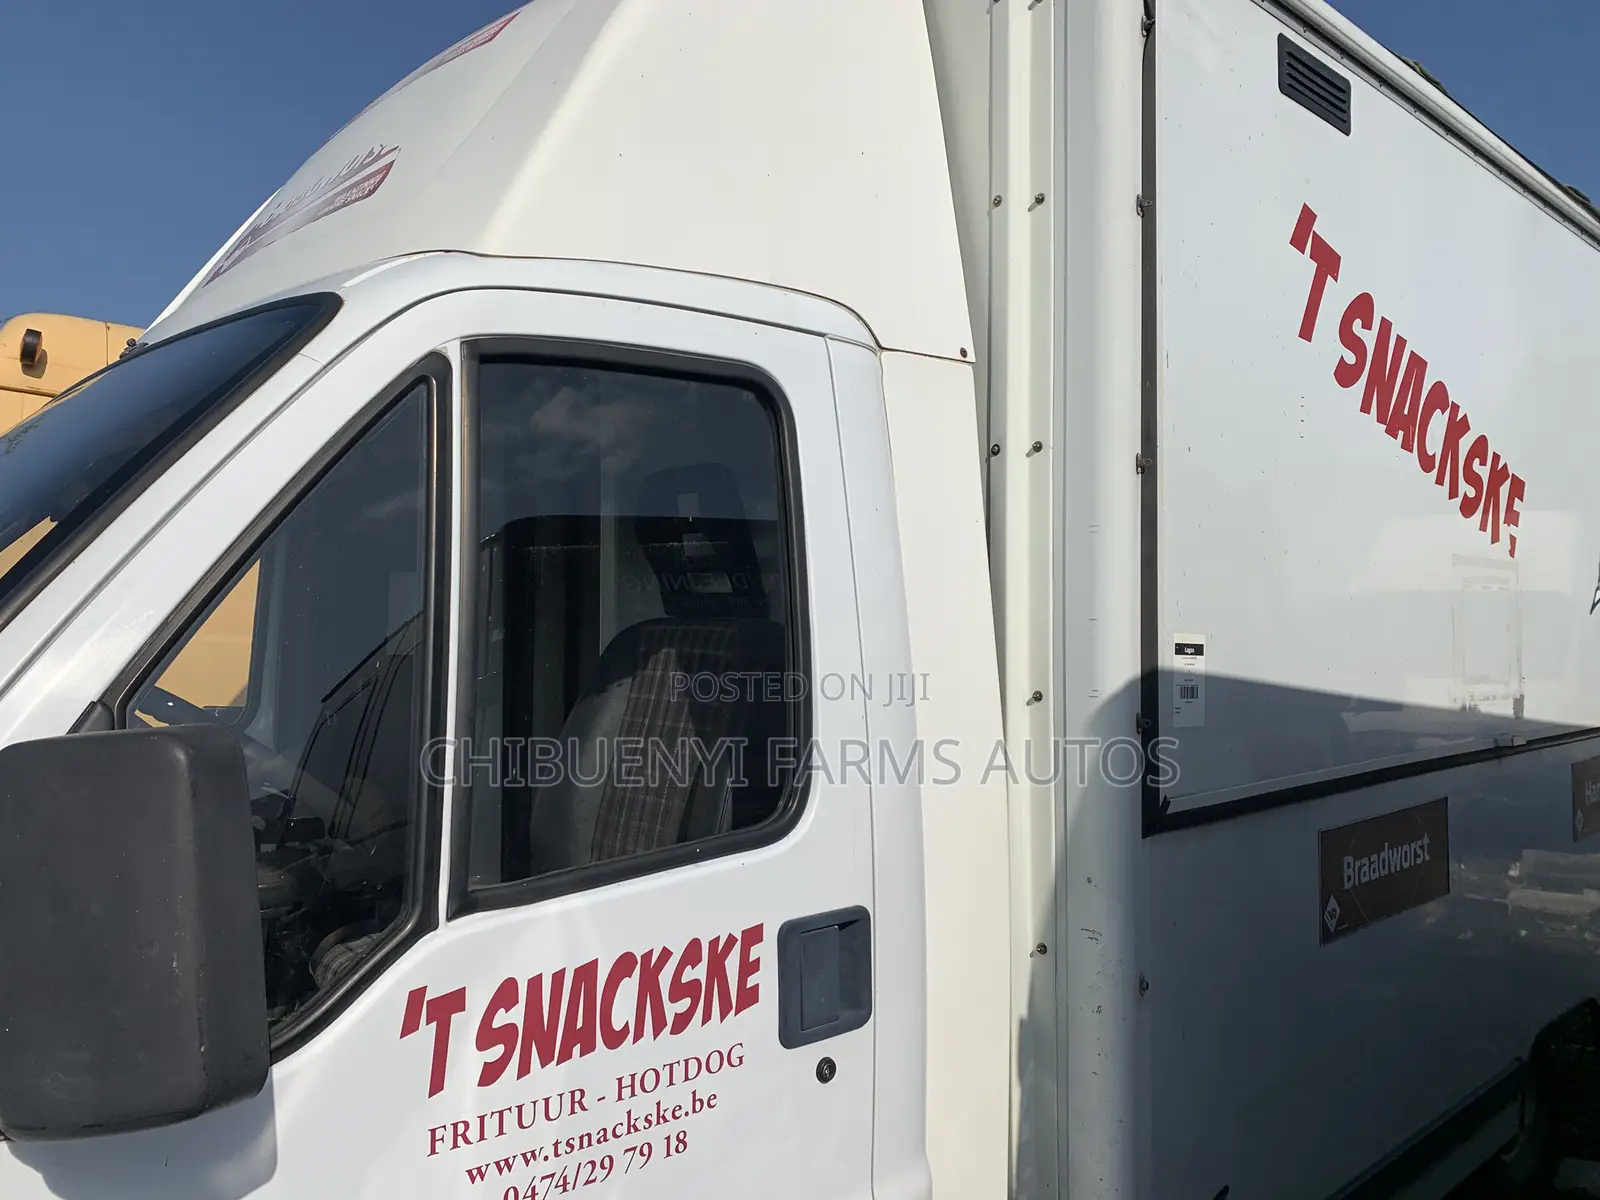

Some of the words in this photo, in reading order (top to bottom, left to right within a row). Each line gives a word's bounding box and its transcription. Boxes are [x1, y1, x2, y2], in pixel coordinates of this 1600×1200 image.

[1333, 291, 1526, 558] SNACKSKE
[1342, 832, 1431, 891] Braadworst
[400, 985, 466, 1099] 'T
[475, 922, 764, 1088] SNACKSKE
[426, 1087, 589, 1157] FRITUUR
[615, 1042, 745, 1103] HOTDOG
[465, 1089, 718, 1185] www.tsnackske.be
[622, 1141, 653, 1175] 79
[663, 1129, 688, 1159] 18
